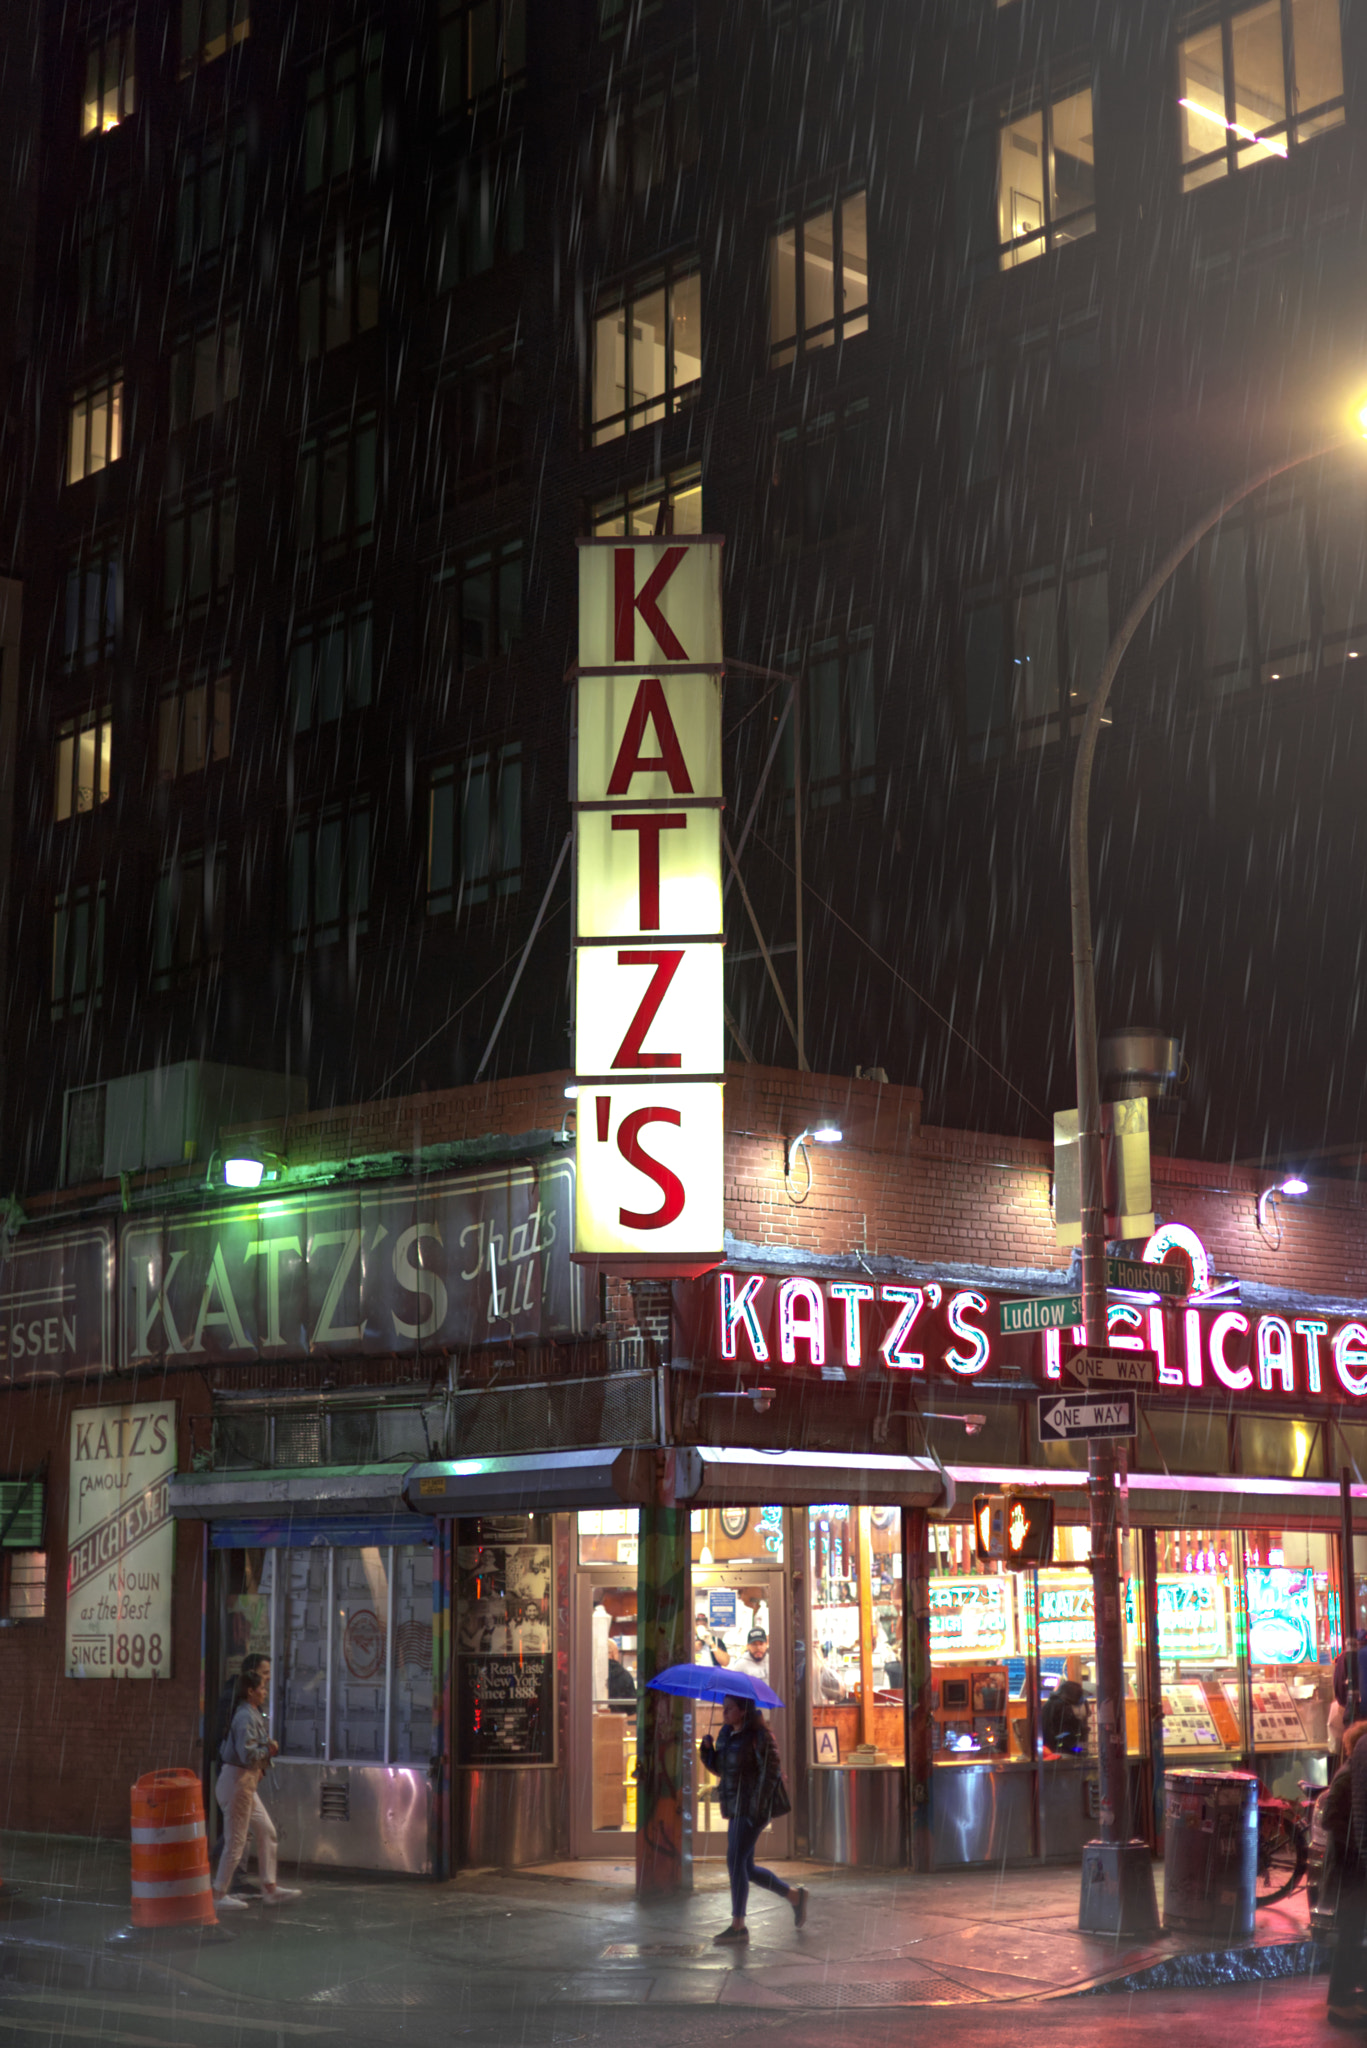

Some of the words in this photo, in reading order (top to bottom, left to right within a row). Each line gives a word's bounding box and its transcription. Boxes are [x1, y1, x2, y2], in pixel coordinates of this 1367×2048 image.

[459, 1201, 557, 1280] That's
[131, 1222, 447, 1357] KATZ'S
[1118, 1263, 1171, 1292] Houston
[1174, 1269, 1184, 1285] St
[719, 1273, 990, 1375] KATZ'S
[1003, 1302, 1065, 1330] Ludlow
[1071, 1299, 1082, 1315] St
[1075, 1359, 1104, 1377] ONE
[1117, 1361, 1146, 1380] WAY
[1053, 1408, 1081, 1426] ONE
[1094, 1405, 1123, 1424] WAY
[74, 1413, 169, 1462] KATZ'S
[71, 1482, 170, 1586] DELICATESSEN
[108, 1568, 160, 1592] KNOWN
[81, 1607, 96, 1620] as
[97, 1595, 118, 1620] the
[120, 1594, 152, 1620] Best
[72, 1646, 107, 1665] SINCE
[490, 1662, 516, 1675] Real
[520, 1662, 545, 1674] Taste
[473, 1688, 506, 1700] Since
[483, 1675, 511, 1688] New
[820, 1732, 834, 1754] A
